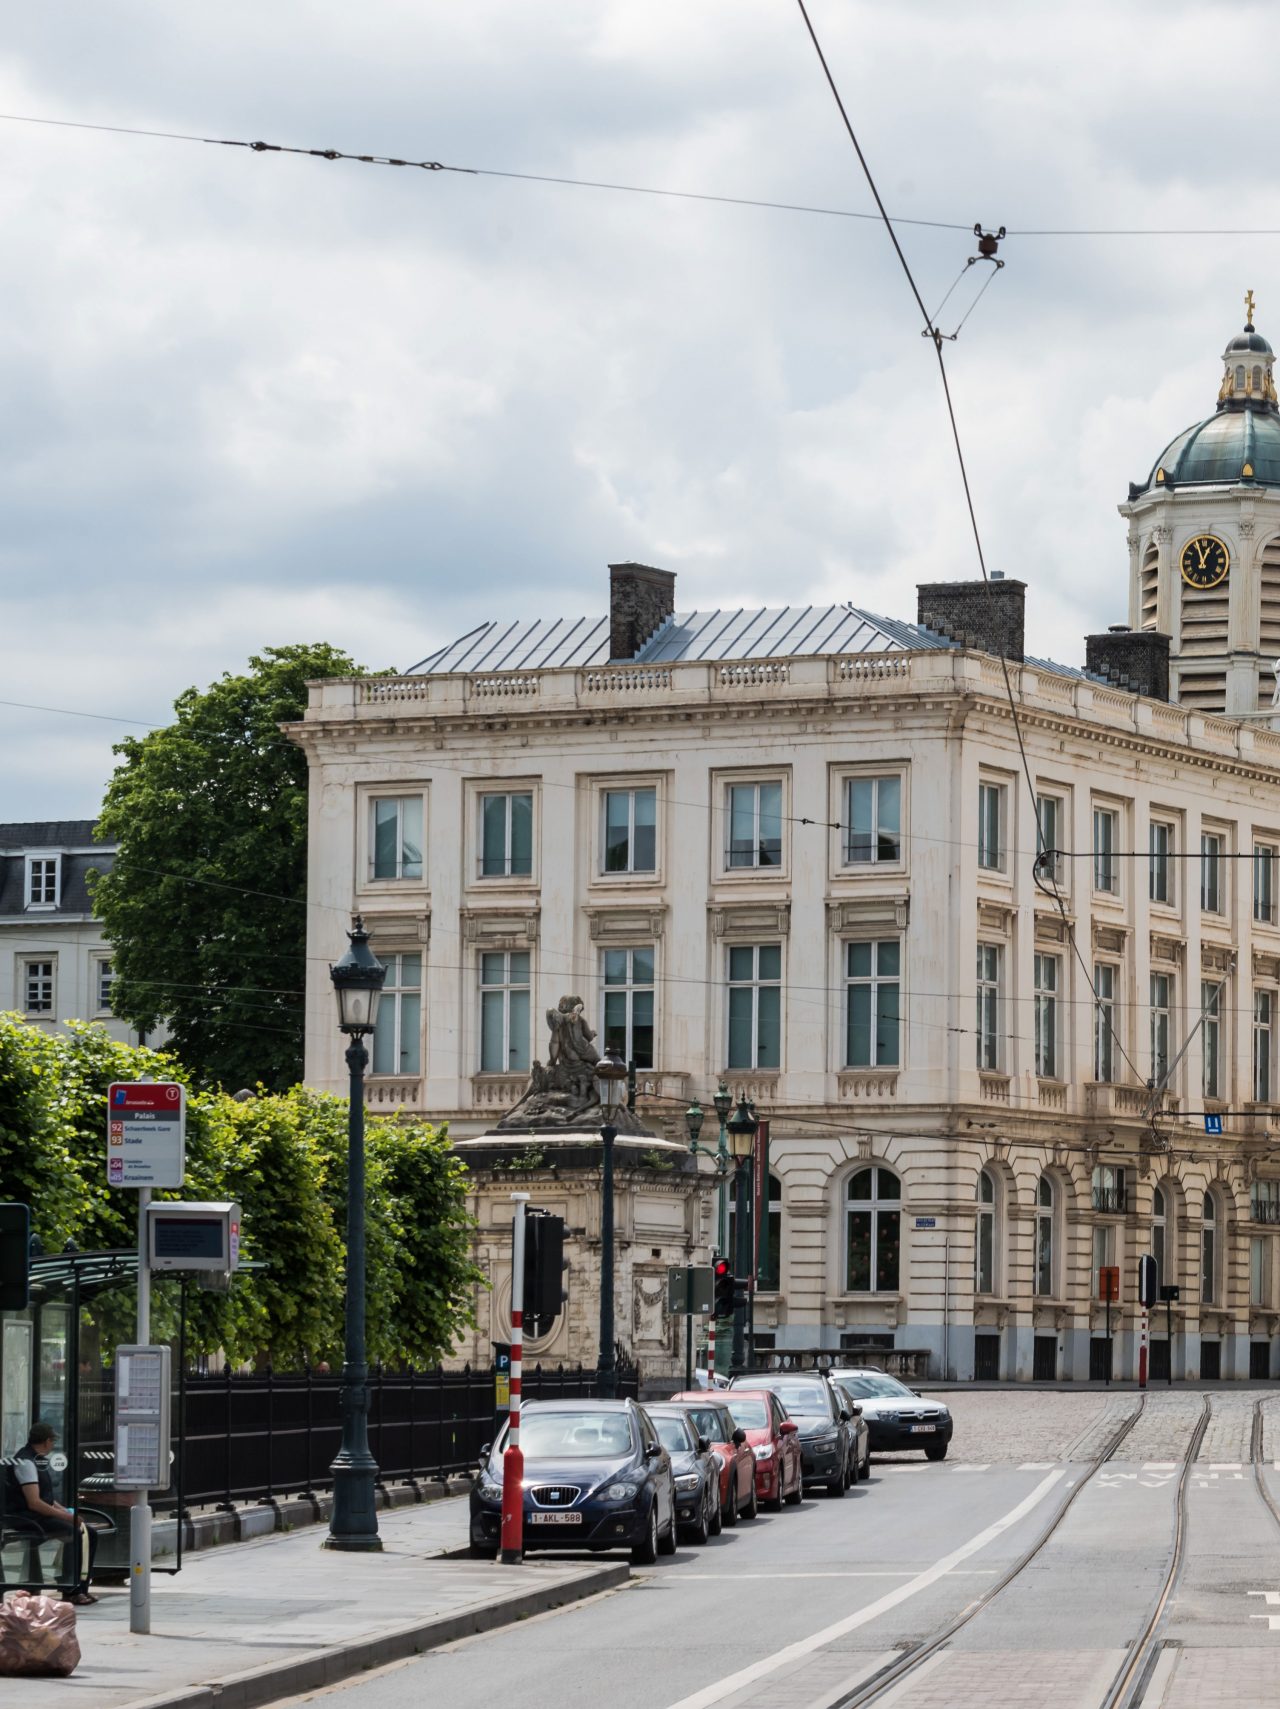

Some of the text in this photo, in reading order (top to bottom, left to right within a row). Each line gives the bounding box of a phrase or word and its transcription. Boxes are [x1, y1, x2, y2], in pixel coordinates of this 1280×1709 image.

[134, 1112, 156, 1120] Palais
[111, 1123, 122, 1132] 92
[111, 1136, 122, 1144] 93
[499, 1355, 509, 1368] P
[533, 1512, 581, 1523] 1-AKL-588
